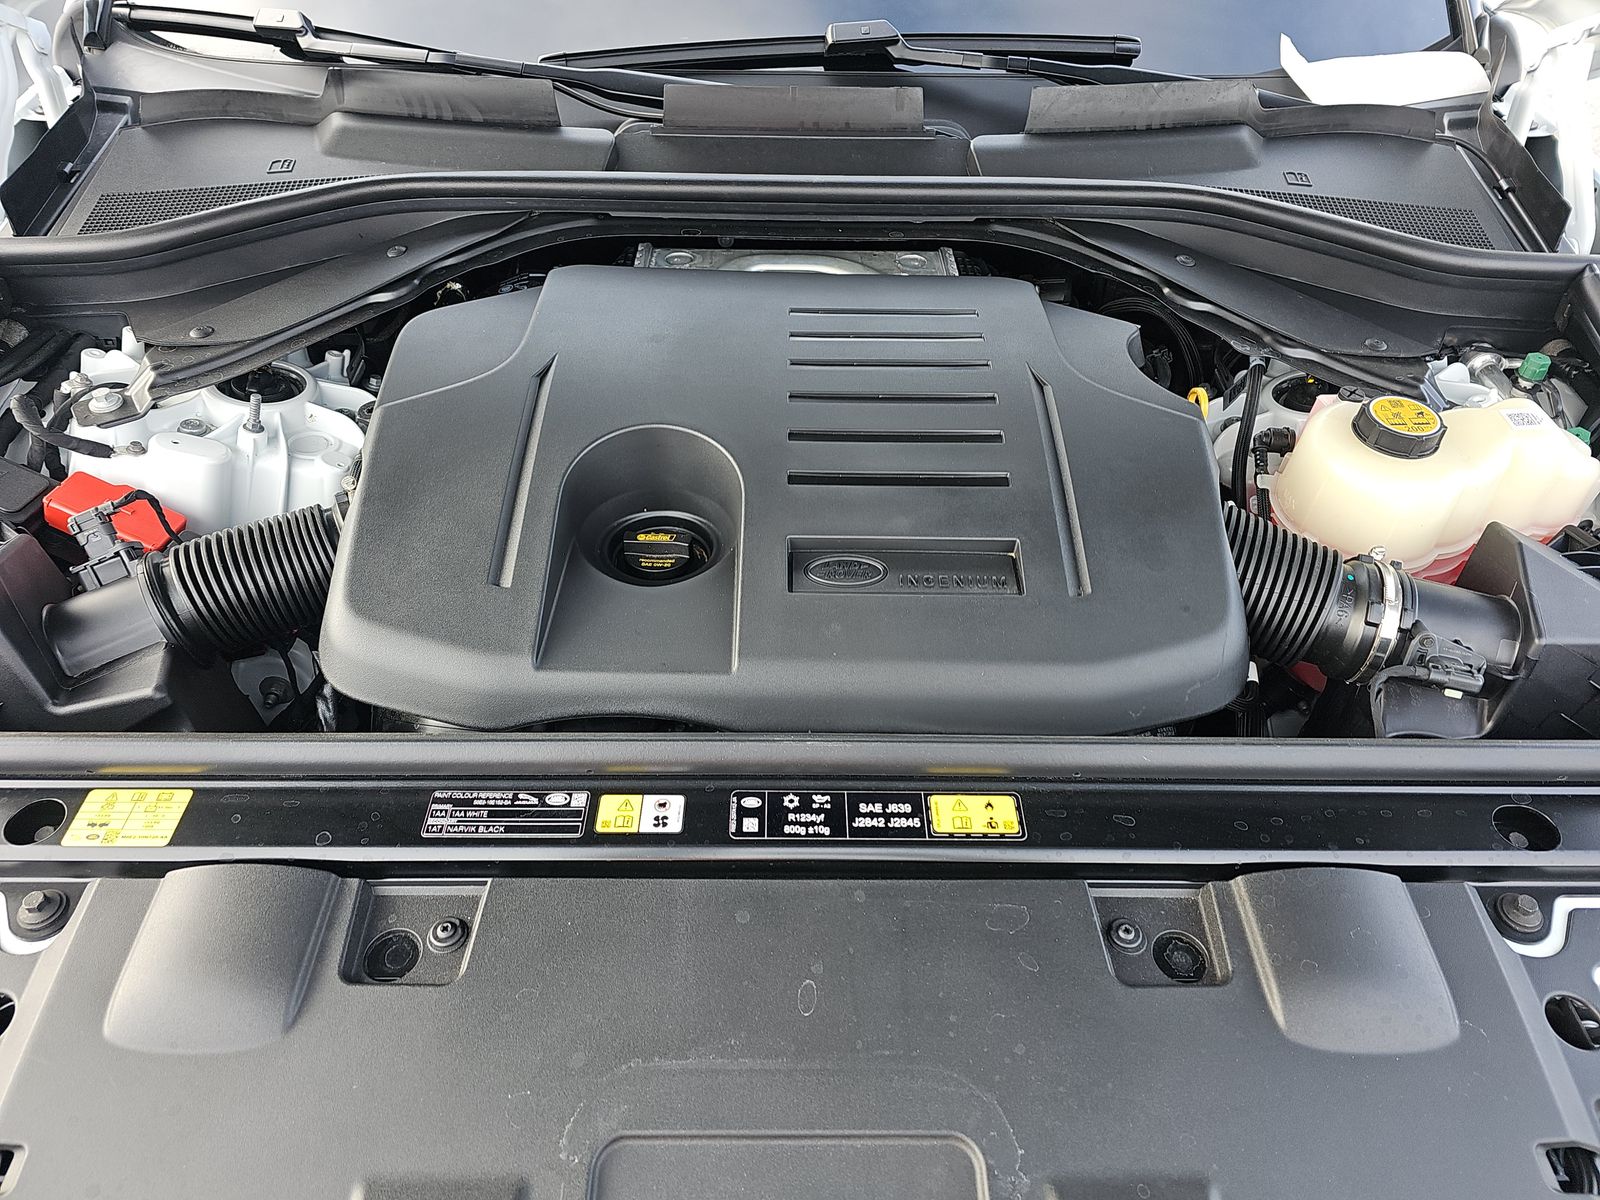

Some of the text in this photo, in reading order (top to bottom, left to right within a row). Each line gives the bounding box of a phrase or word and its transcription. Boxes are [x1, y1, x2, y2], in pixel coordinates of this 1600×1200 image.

[646, 533, 670, 541] Castrol
[899, 573, 1008, 589] INGENIUM
[859, 802, 912, 813] SAE J639
[787, 813, 825, 823] R1234yf
[852, 816, 921, 828] J2842 J2845
[447, 825, 476, 833] NARVIK
[478, 825, 505, 833] BLACK
